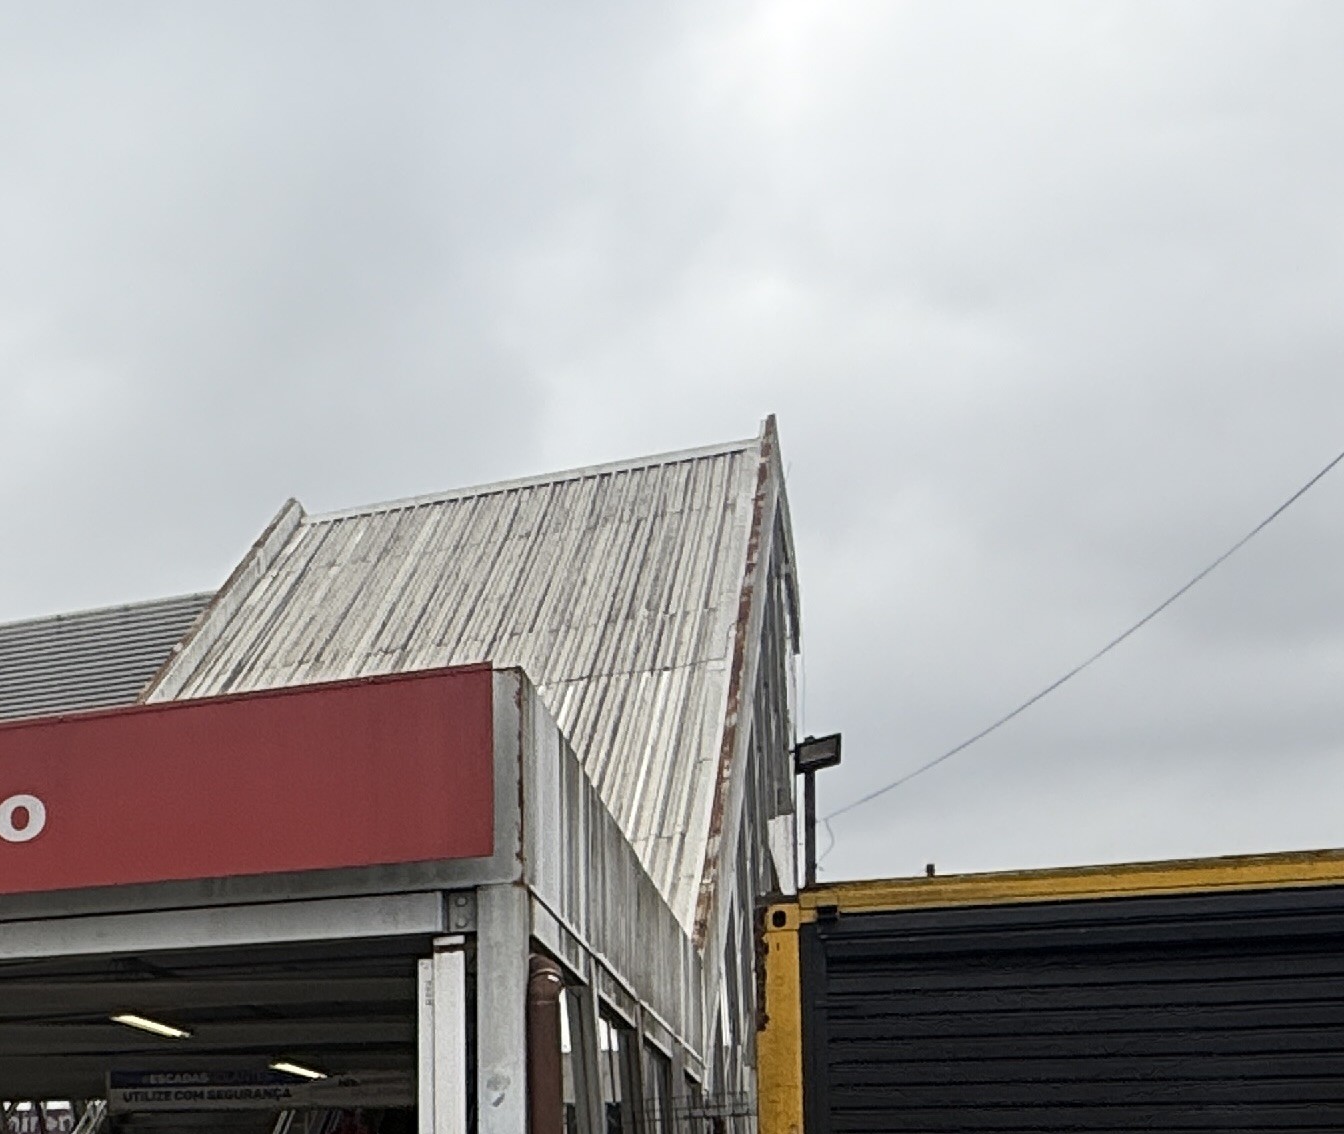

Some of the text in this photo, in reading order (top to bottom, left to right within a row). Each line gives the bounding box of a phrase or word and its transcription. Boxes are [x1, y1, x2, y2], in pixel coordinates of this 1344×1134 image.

[122, 1087, 292, 1102] UTILIZE COM SEGURANÇA
